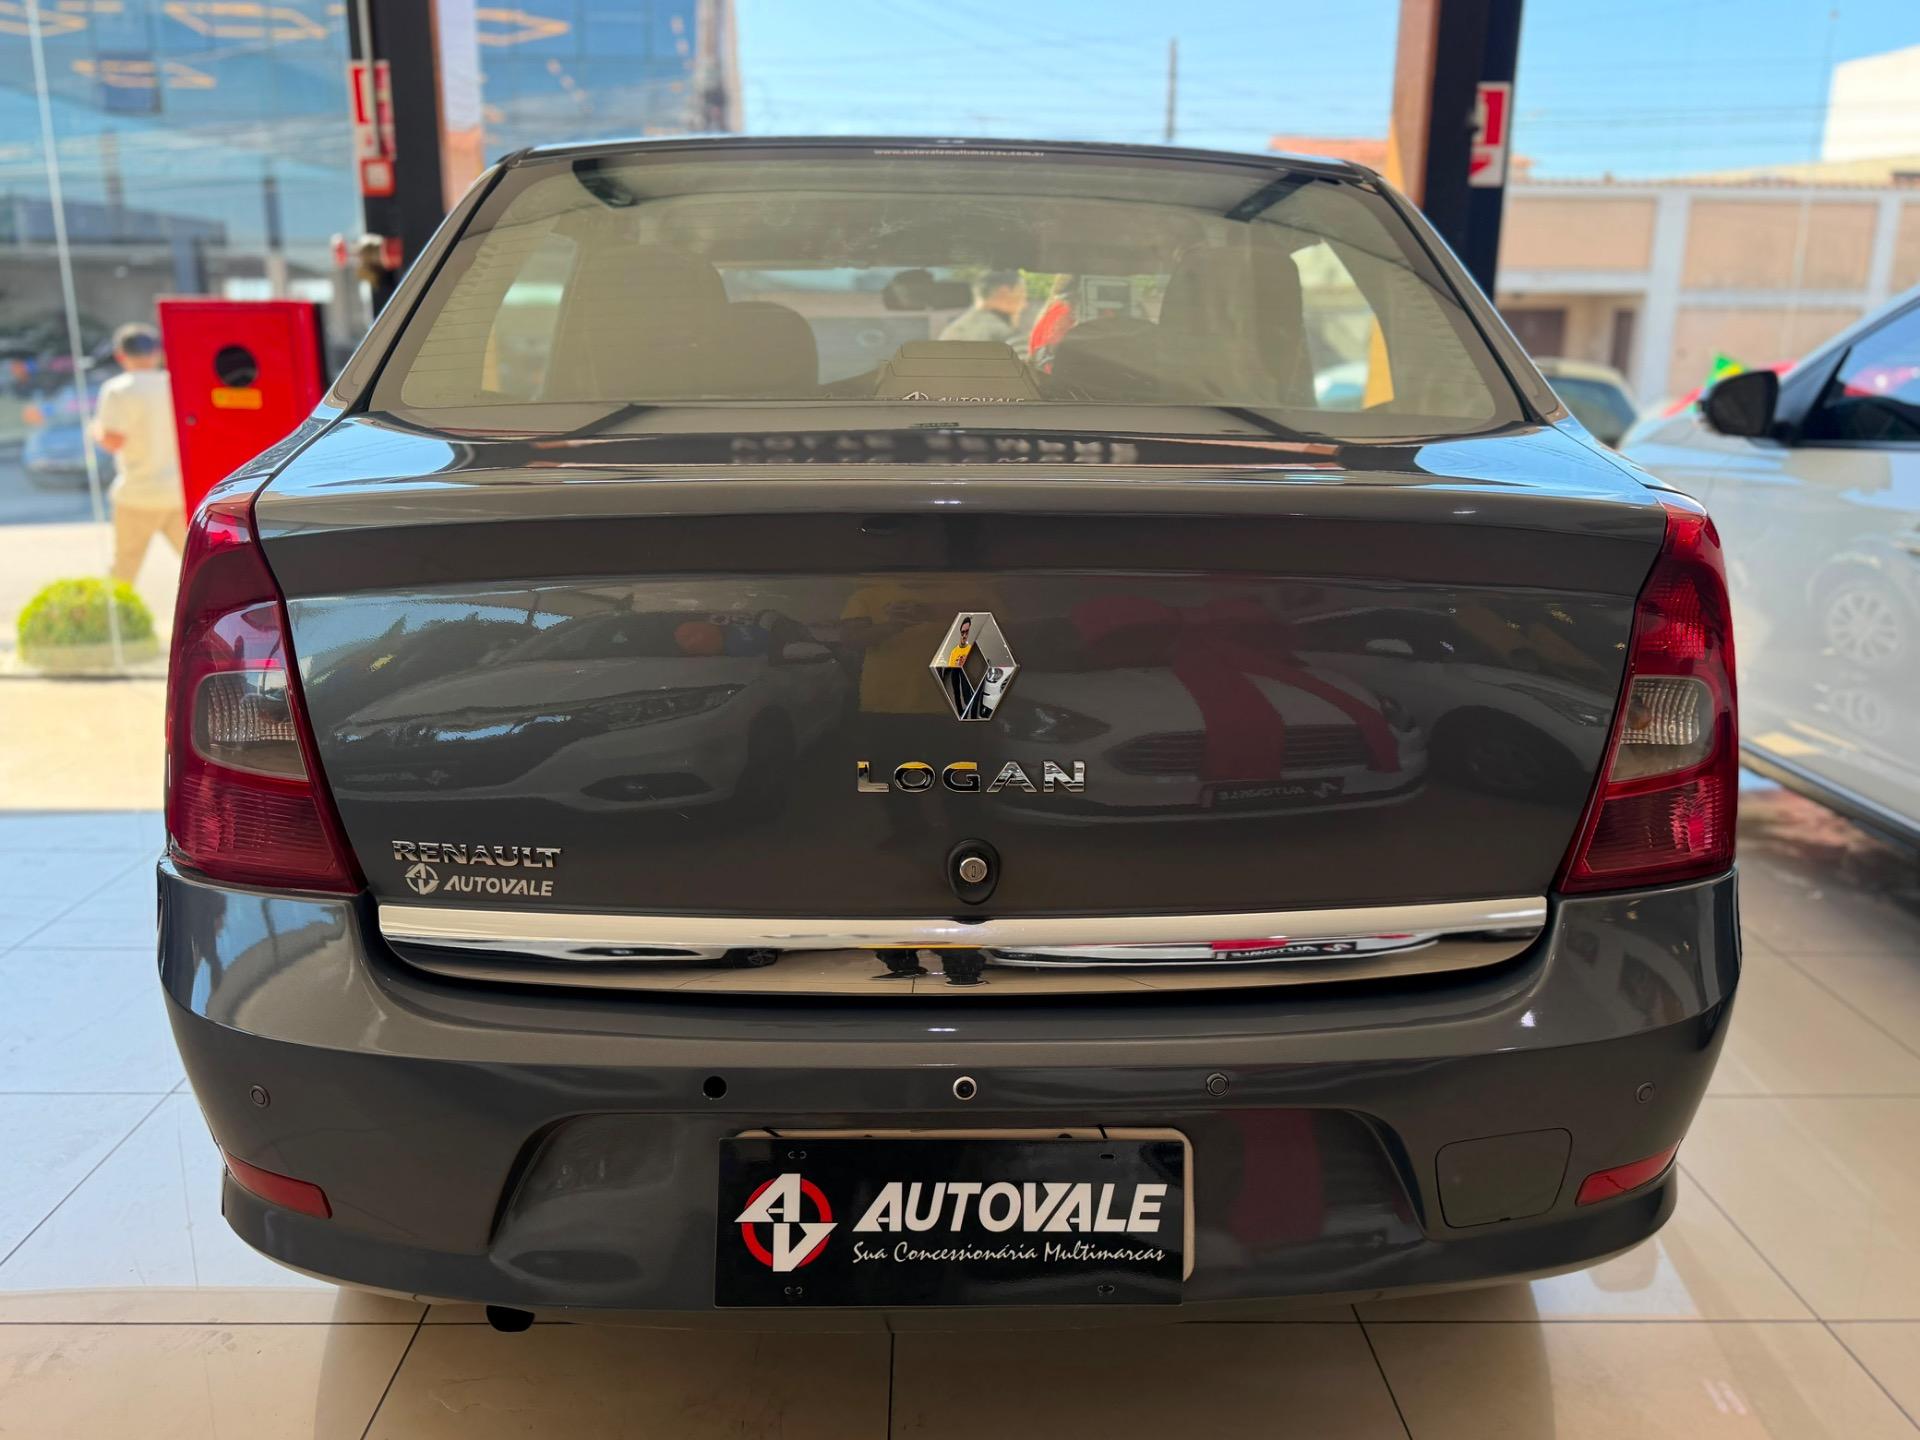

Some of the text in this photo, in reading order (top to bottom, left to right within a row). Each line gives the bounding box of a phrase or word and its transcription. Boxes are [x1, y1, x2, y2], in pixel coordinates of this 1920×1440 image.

[857, 761, 1085, 793] LOGAN
[392, 840, 561, 868] RENAULT
[443, 875, 554, 897] AUTOVALE
[852, 1182, 1168, 1232] AUTOVALE
[852, 1240, 1166, 1263] Sua Concessionária Multimarcas
